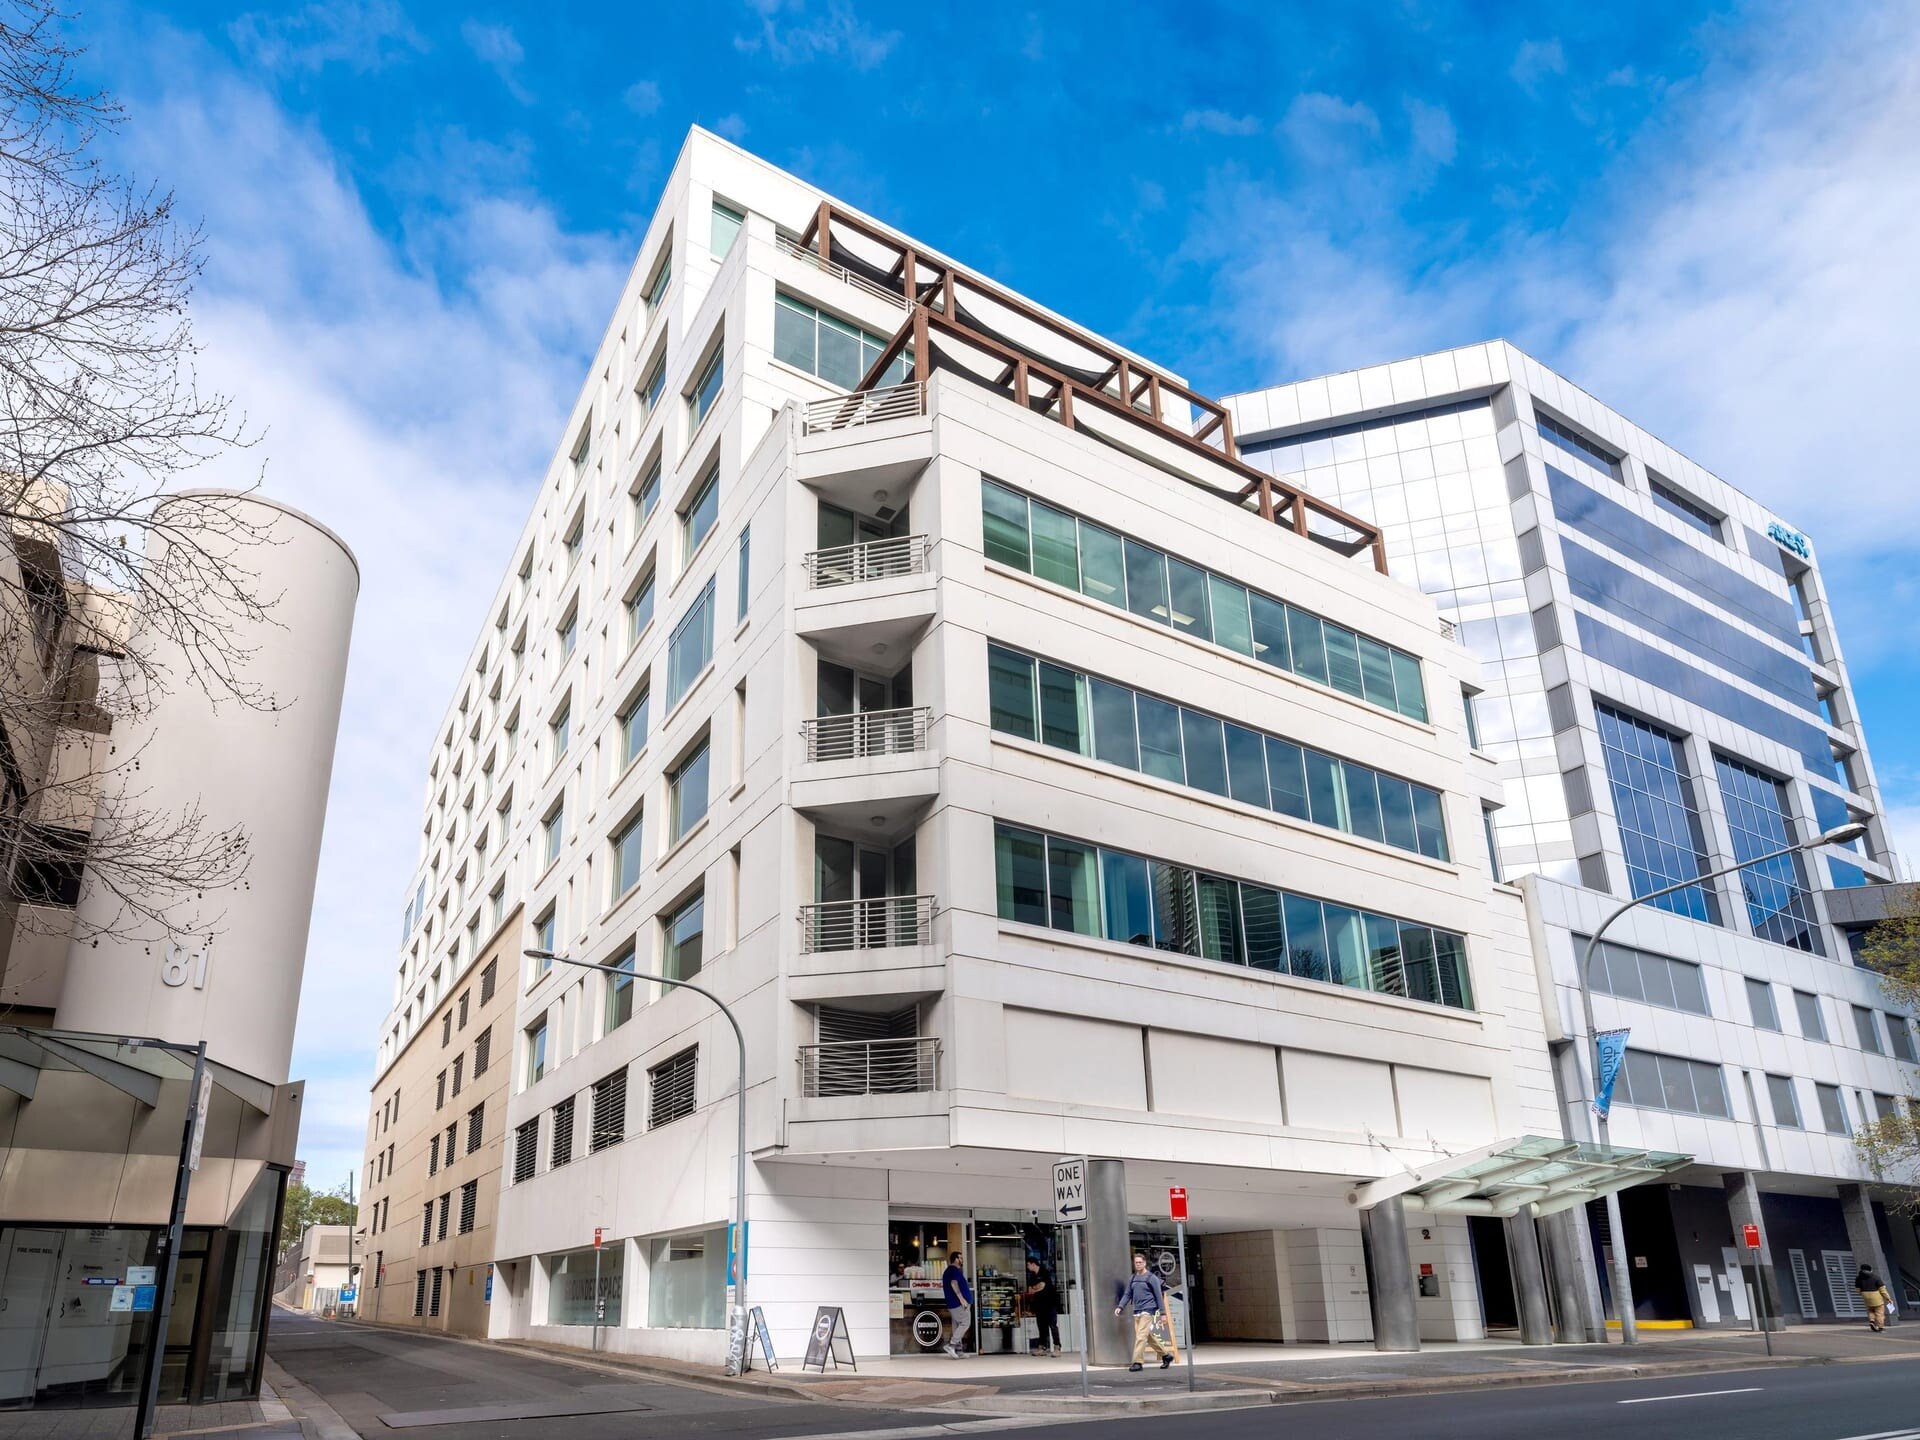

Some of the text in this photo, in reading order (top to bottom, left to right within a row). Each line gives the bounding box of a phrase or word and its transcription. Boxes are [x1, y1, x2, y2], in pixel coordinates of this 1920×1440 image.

[161, 942, 209, 990] 81
[1057, 1166, 1080, 1182] ONE
[1056, 1184, 1081, 1200] WAY
[599, 1275, 622, 1300] SPACE
